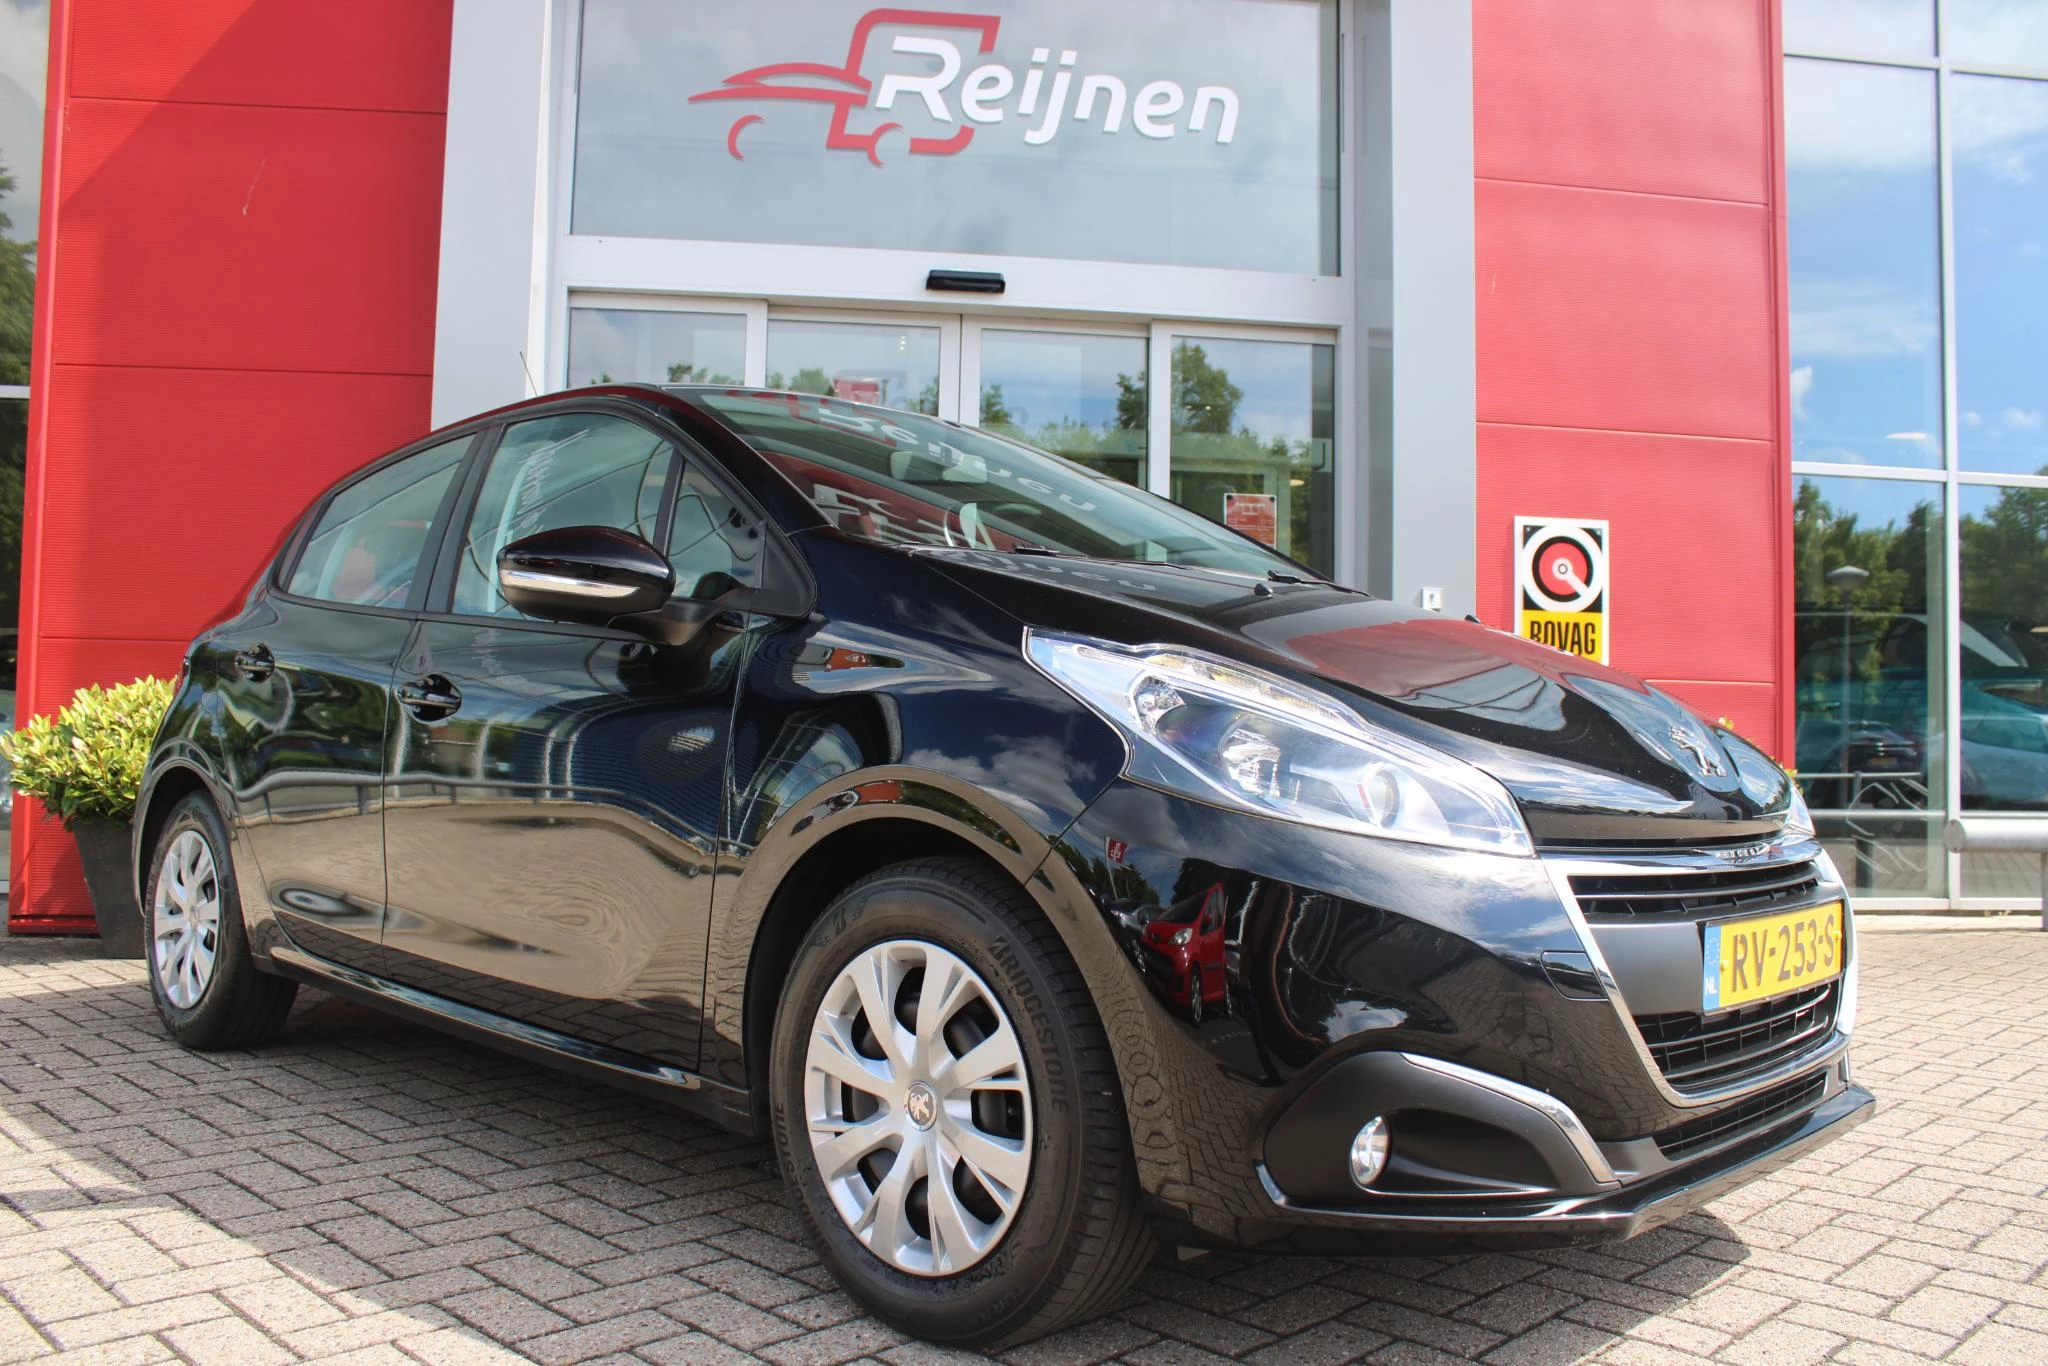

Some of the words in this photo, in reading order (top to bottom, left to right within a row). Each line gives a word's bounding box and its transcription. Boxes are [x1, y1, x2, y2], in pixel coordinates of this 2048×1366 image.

[874, 36, 1240, 146] Reijnen
[1530, 620, 1596, 656] BOVAG
[1704, 976, 1718, 996] NL
[1731, 914, 1835, 993] RV-253-S
[987, 935, 1069, 1114] BRIDGESTONE
